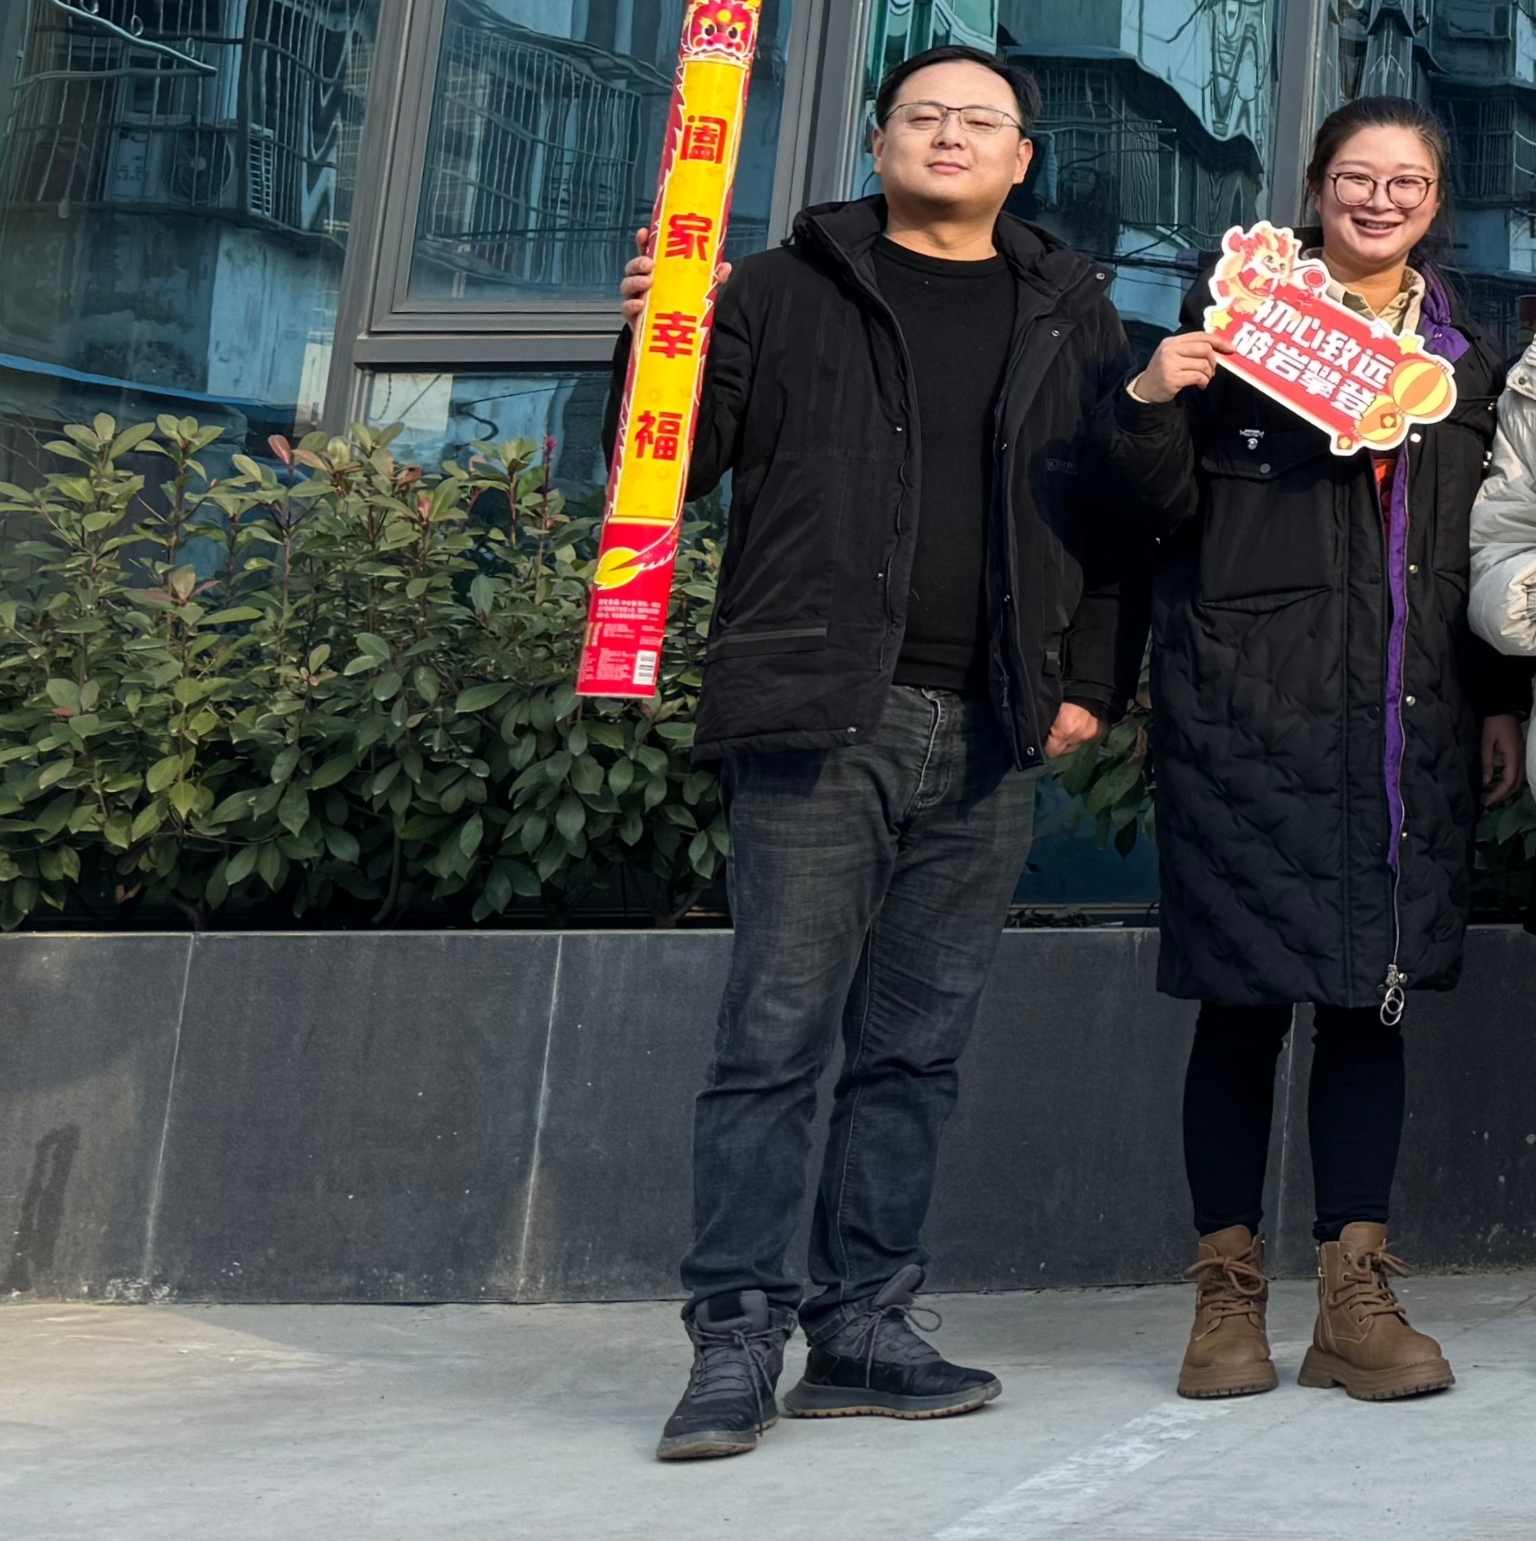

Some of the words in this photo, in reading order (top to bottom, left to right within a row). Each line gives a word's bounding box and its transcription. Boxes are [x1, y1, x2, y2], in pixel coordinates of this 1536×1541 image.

[634, 114, 728, 463] 阖家幸福
[1231, 321, 1377, 422] 破岩攀登
[1252, 298, 1397, 390] 初心致远
